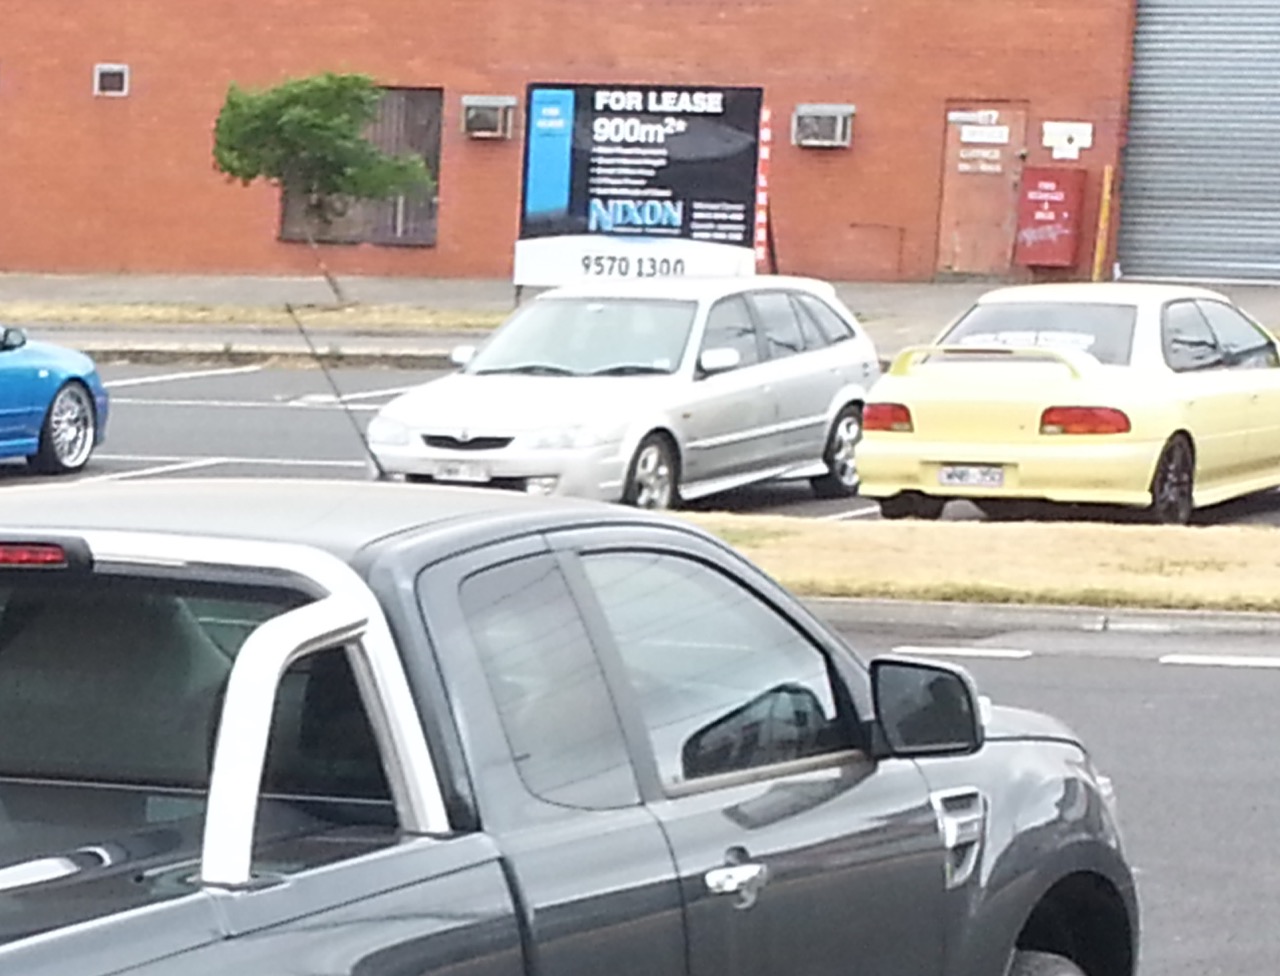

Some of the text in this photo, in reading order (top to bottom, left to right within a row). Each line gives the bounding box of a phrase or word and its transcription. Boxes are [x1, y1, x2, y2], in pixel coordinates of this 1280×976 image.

[595, 90, 723, 113] FOR LEASE
[589, 198, 683, 232] NIXON
[582, 255, 630, 276] 9570
